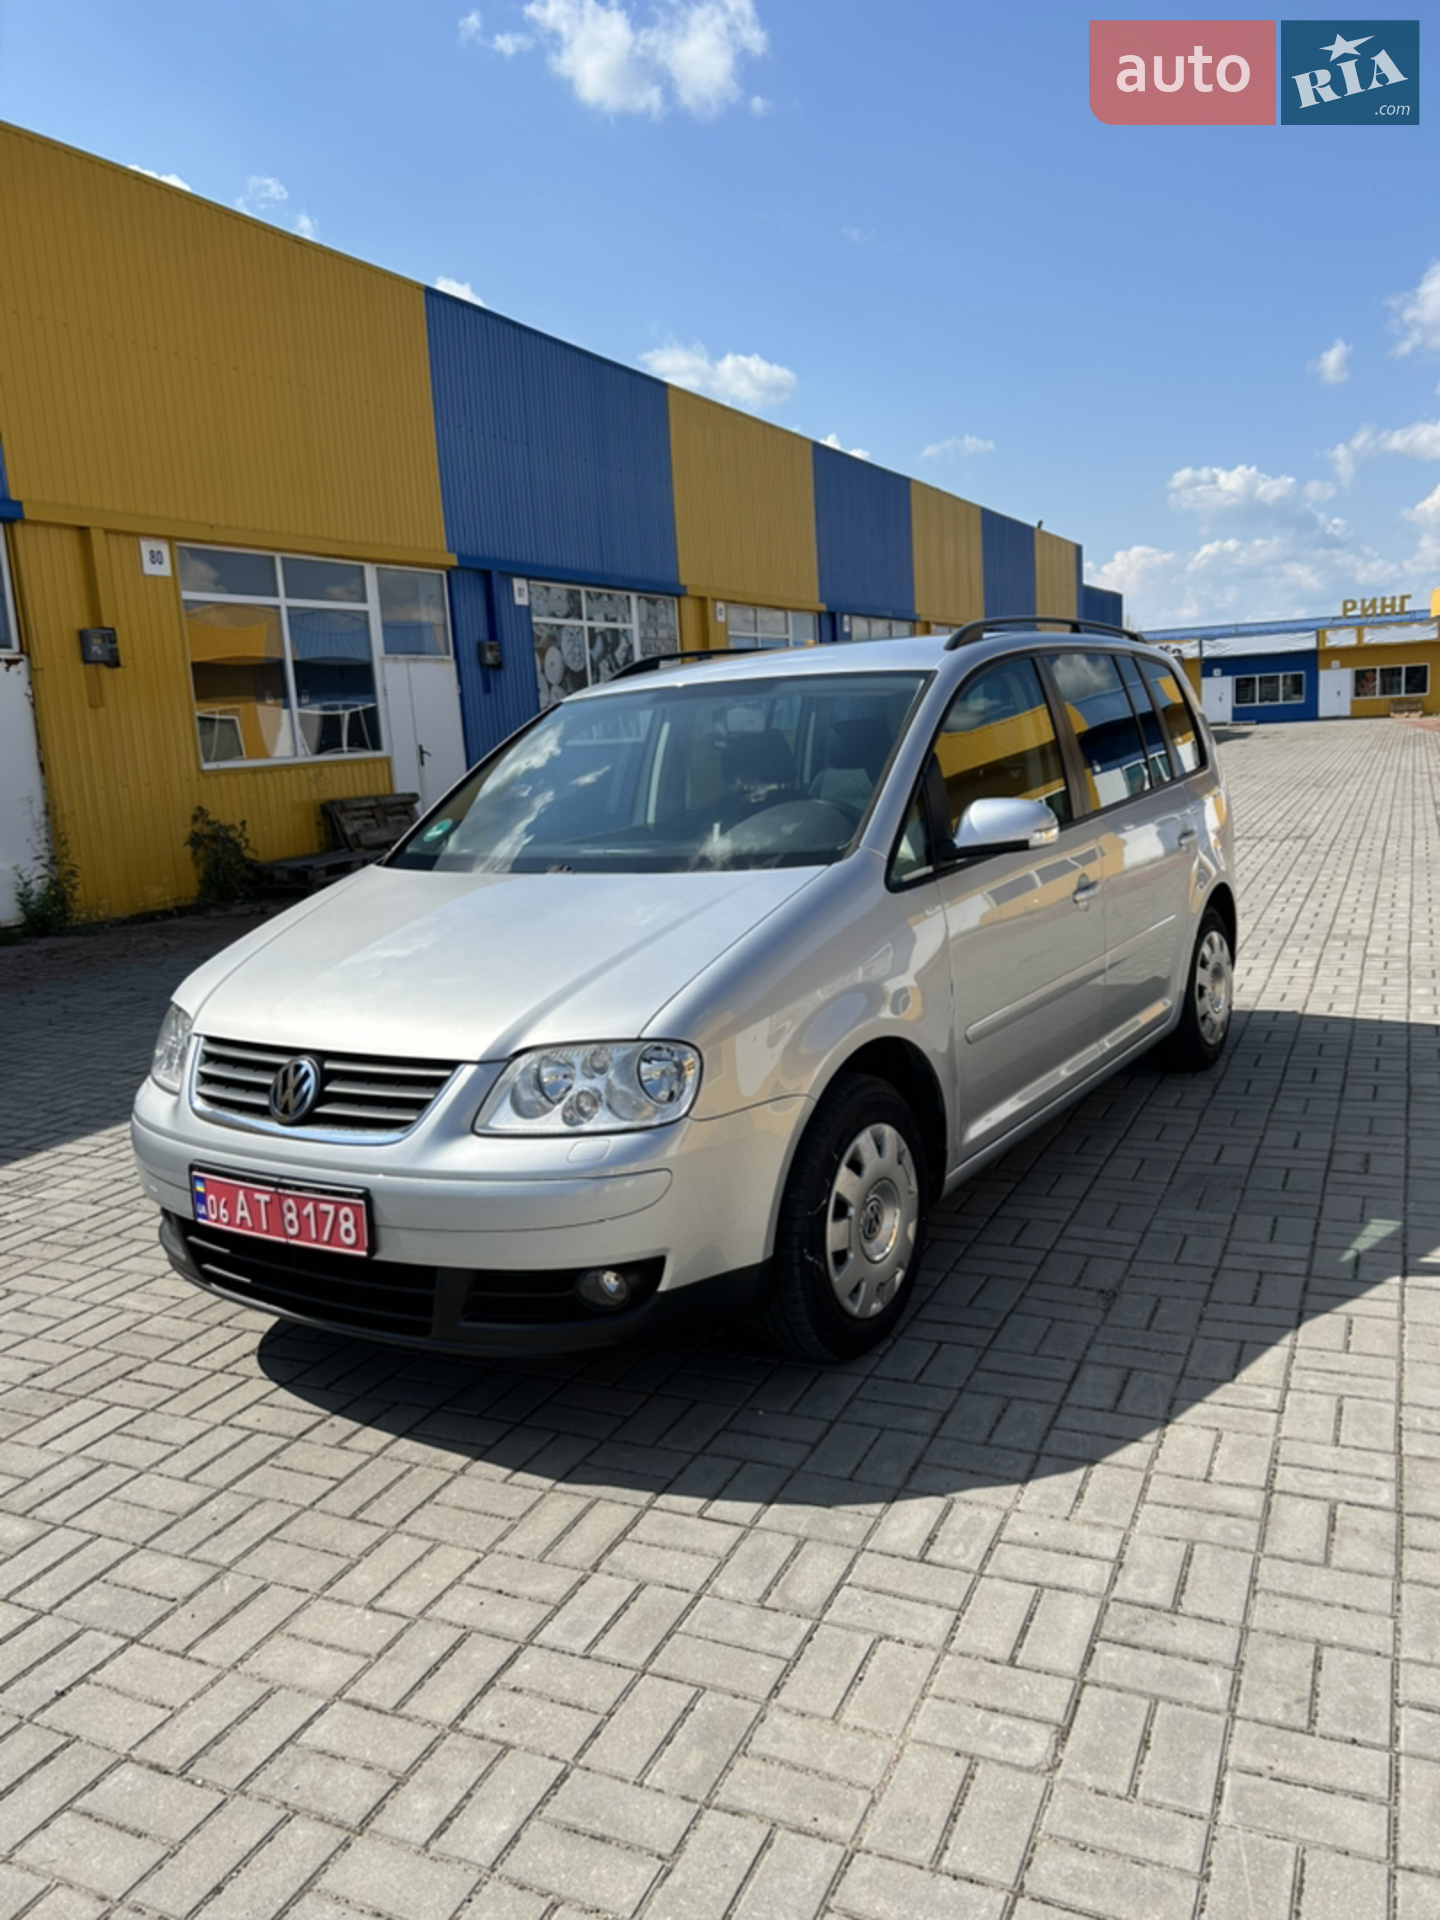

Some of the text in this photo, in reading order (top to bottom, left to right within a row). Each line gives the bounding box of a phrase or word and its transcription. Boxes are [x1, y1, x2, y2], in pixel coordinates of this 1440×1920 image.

[149, 549, 164, 565] 80
[1342, 594, 1412, 619] РИНГ
[282, 1198, 357, 1245] 8178
